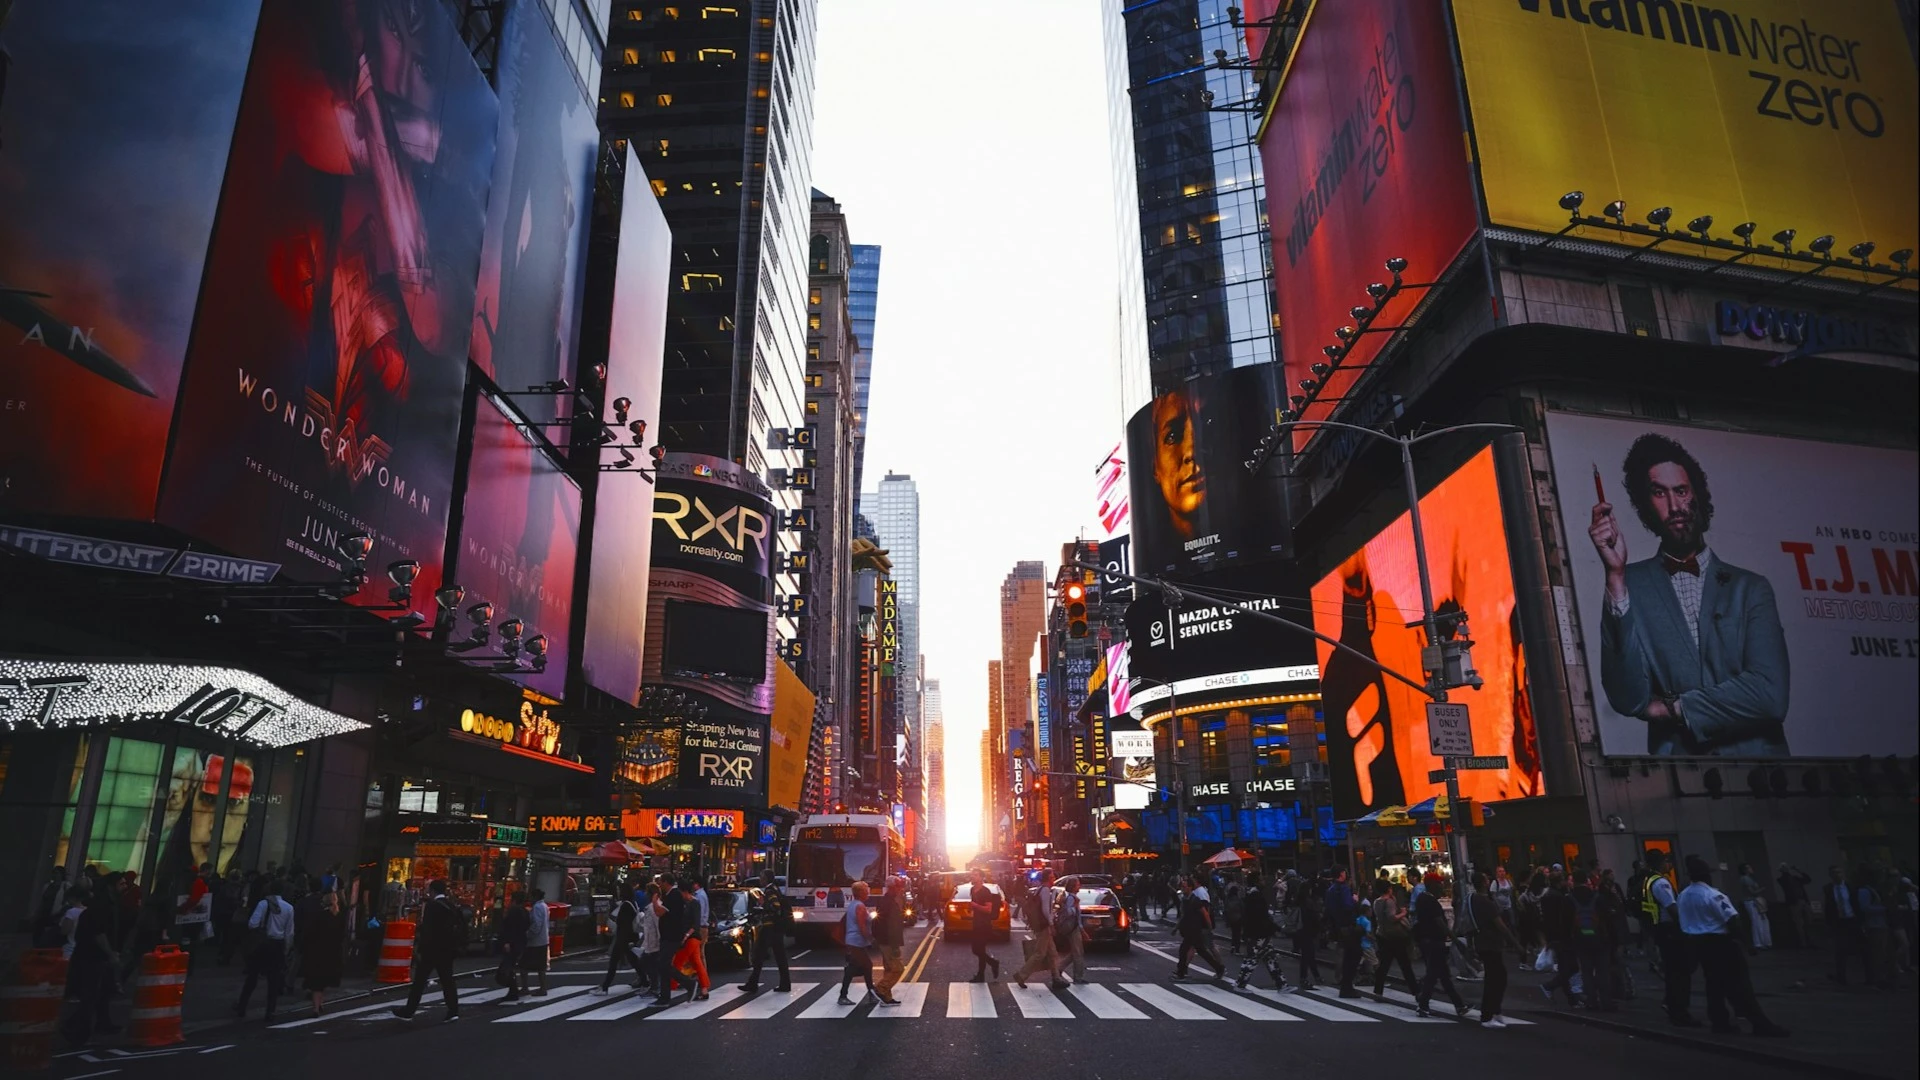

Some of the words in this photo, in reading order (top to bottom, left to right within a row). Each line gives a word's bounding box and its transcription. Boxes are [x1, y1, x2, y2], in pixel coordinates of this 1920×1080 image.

[1748, 70, 1885, 139] zero
[1357, 74, 1416, 206] zero
[238, 367, 350, 462] WONDER
[362, 453, 431, 517] WOMAN
[245, 456, 263, 474] THE
[266, 468, 300, 494] FUTURE
[303, 489, 315, 502] OF
[317, 499, 348, 521] JUSTICE
[351, 517, 377, 538] BEGINS
[380, 533, 396, 548] WITH
[399, 541, 411, 556] HER
[301, 515, 341, 550] JUN
[653, 491, 768, 560] RXR
[1815, 525, 1834, 538] AN
[1840, 527, 1872, 541] HBO
[679, 542, 744, 564] rxrrealty.com
[791, 430, 810, 657] CHAMPS
[1184, 533, 1221, 552] EQUALITY.
[183, 554, 268, 583] PRIME
[469, 537, 524, 588] WONDER
[529, 577, 568, 615] WOMAN
[1780, 541, 1871, 594] T.J.
[1872, 547, 1918, 597] M
[650, 579, 695, 590] SHARP
[882, 580, 896, 661] MADAME
[1178, 606, 1219, 625] MAZDA
[1179, 618, 1233, 639] SERVICES
[1850, 636, 1902, 658] JUNE
[1204, 675, 1238, 687] CHASE
[172, 682, 286, 738] LOFT
[1435, 707, 1461, 718] BUSES
[727, 724, 746, 736] New
[747, 727, 761, 739] York
[1039, 716, 1050, 748] STUDIOS
[1439, 719, 1459, 728] ONLY
[685, 735, 701, 746] for
[702, 736, 719, 748] the
[719, 738, 736, 750] 21st
[737, 740, 762, 756] Century
[1093, 714, 1106, 759] VICTORY
[699, 753, 753, 781] RXR
[1467, 758, 1506, 769] Broadway
[710, 778, 746, 788] REALTY
[1095, 764, 1107, 787] NW
[1246, 778, 1296, 793] CHASE
[1013, 758, 1024, 820] REGAL
[1192, 782, 1230, 797] CHASE
[541, 816, 581, 832] KNOW
[656, 813, 735, 833] CHAMPS
[1412, 837, 1440, 852] SODA
